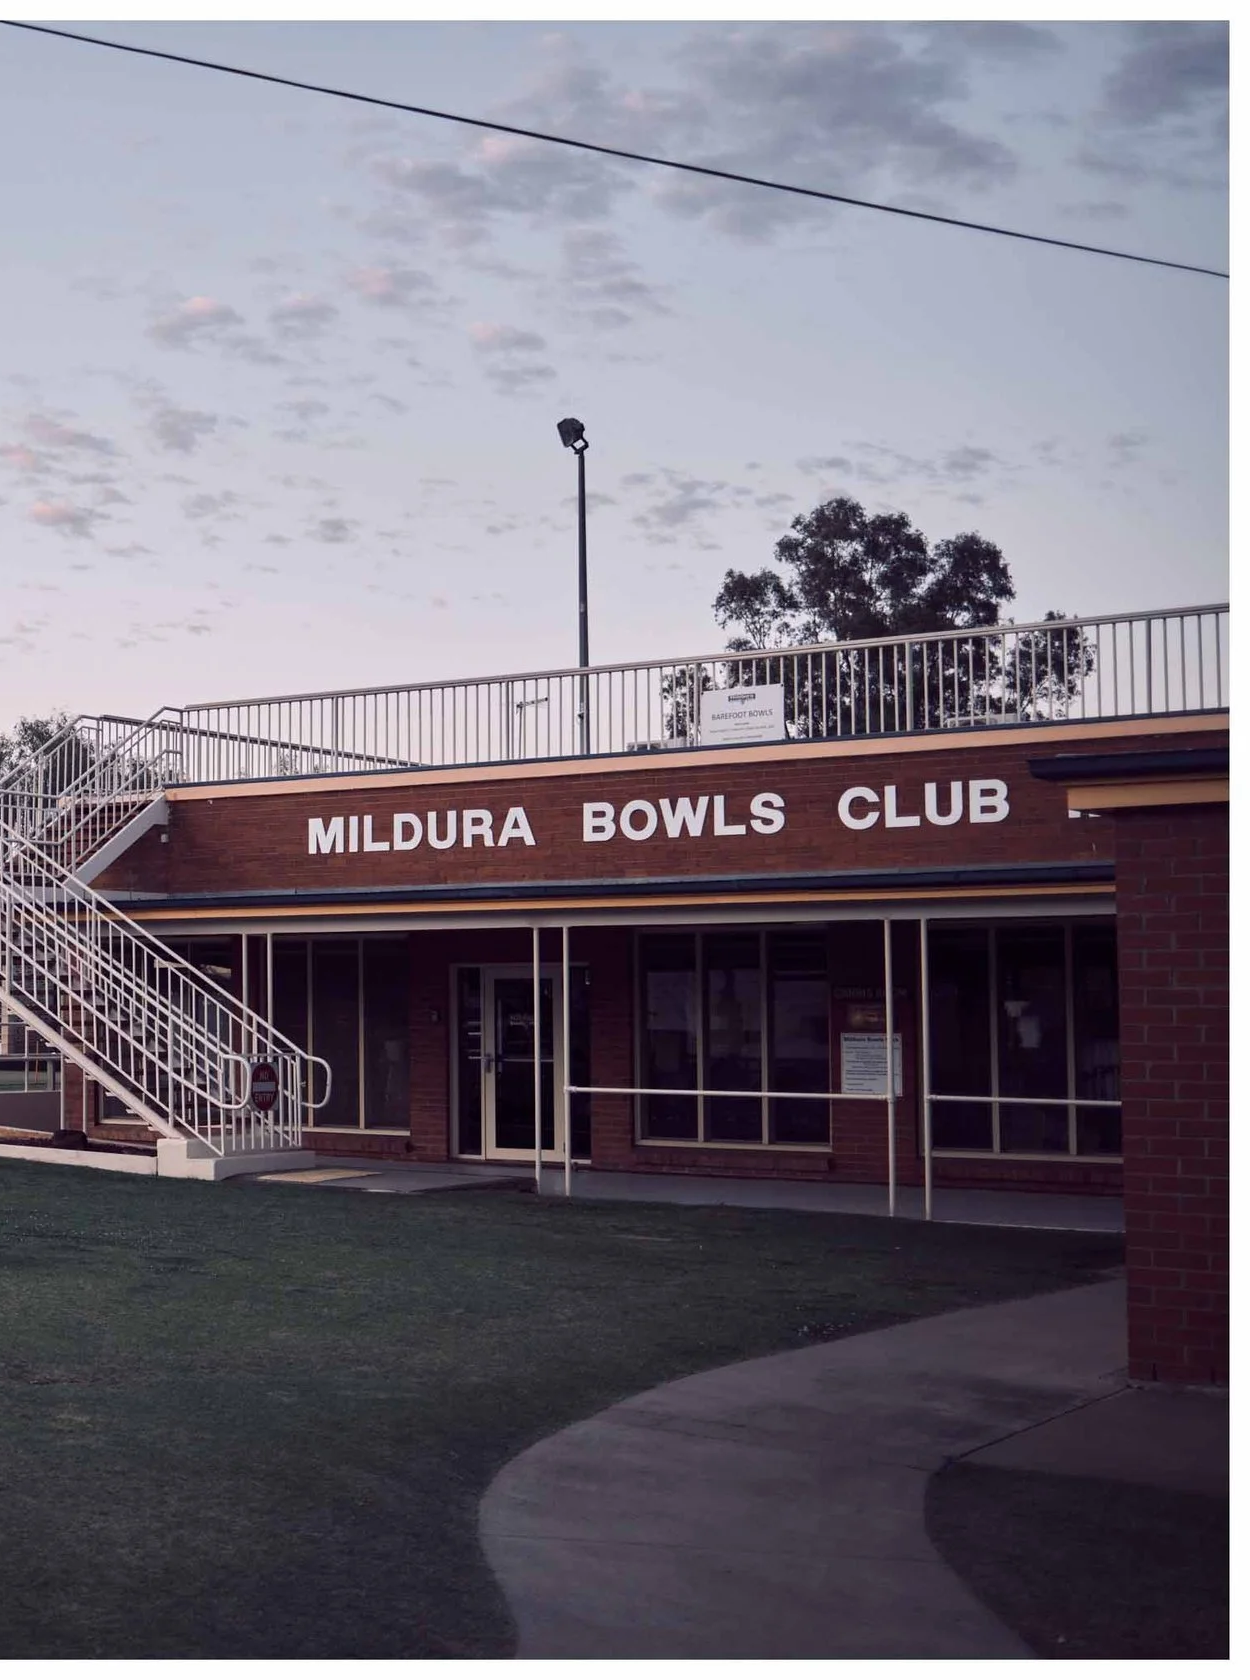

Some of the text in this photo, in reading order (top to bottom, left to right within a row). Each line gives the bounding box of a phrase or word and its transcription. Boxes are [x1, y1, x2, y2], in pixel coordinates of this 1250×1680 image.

[711, 708, 774, 721] BAREFOOT BOWLS
[307, 778, 1011, 856] MILDURA BOWLS CLUB
[259, 1070, 269, 1080] NO
[254, 1092, 275, 1103] ENTRY
